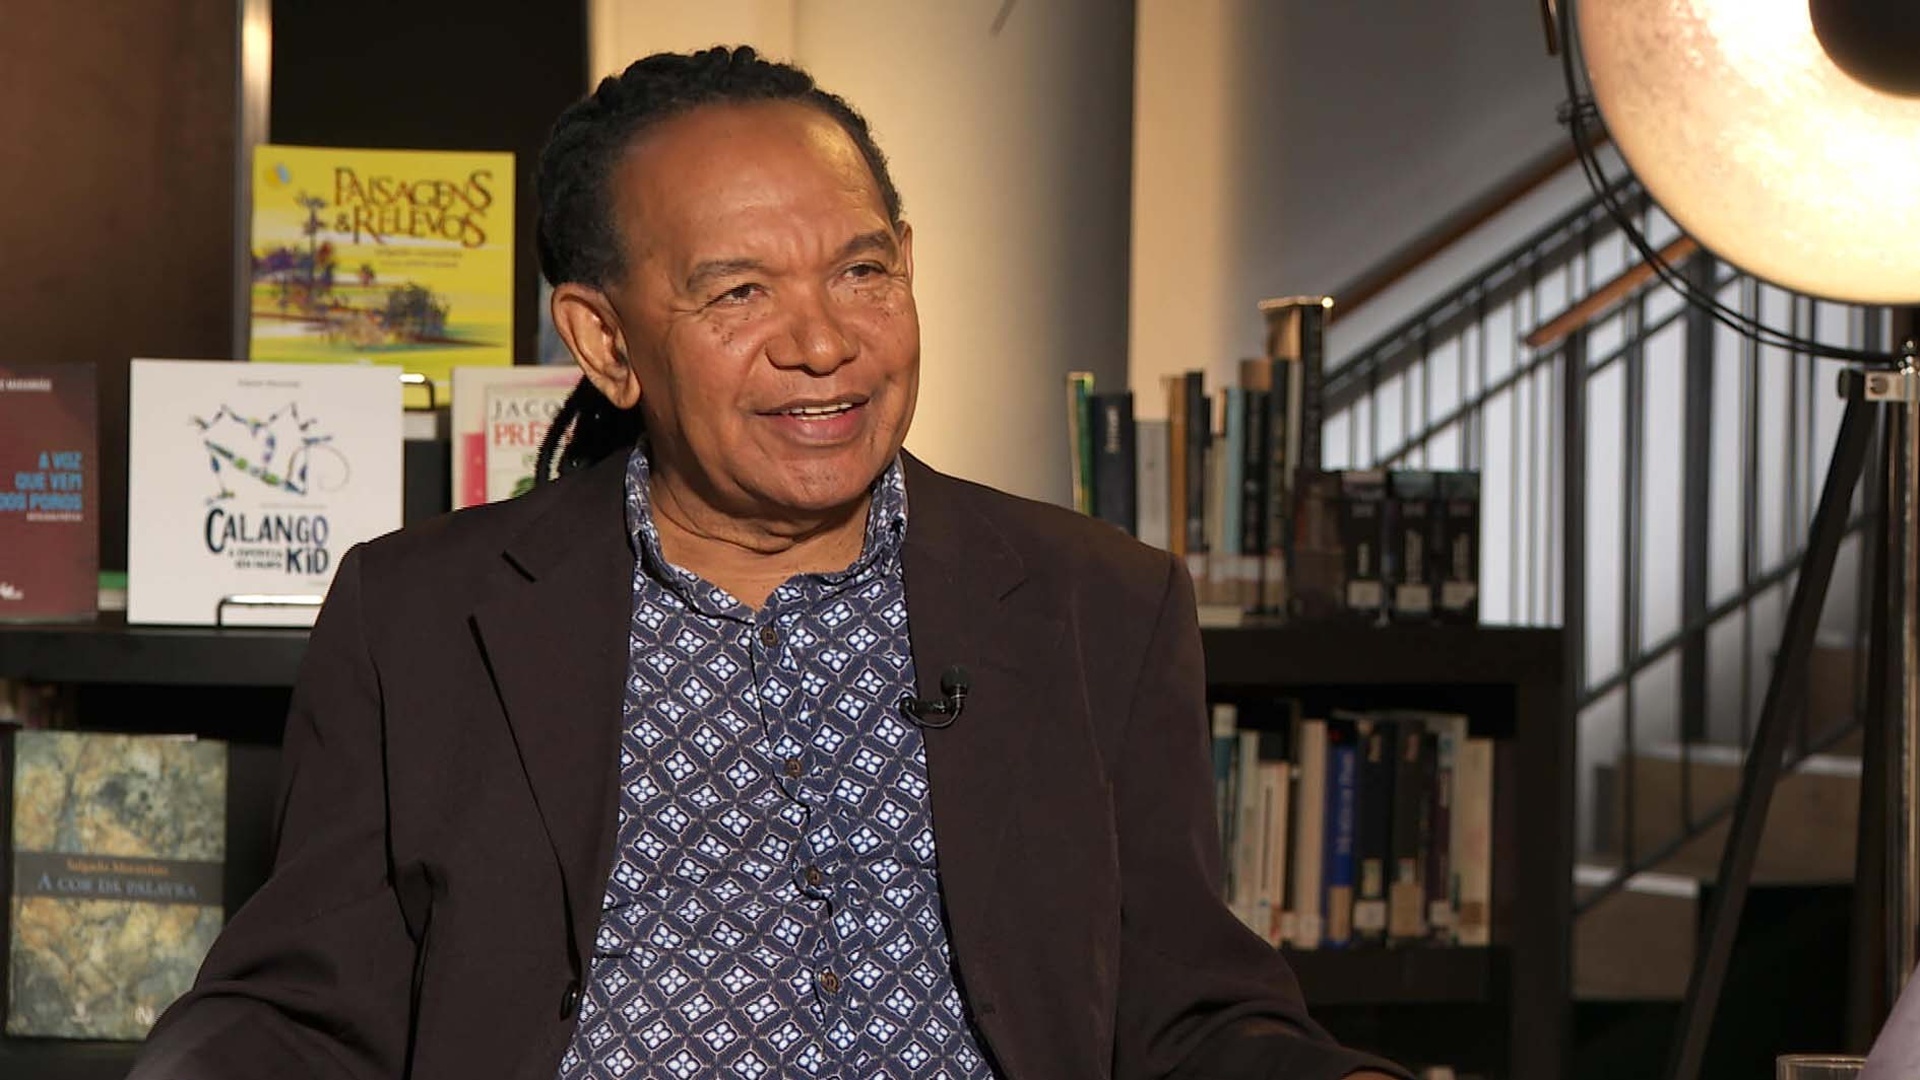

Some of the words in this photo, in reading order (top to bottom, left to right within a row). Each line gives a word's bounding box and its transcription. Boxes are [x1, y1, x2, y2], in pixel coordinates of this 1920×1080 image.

[335, 166, 494, 217] PAISAGENS
[39, 452, 49, 470] A
[53, 451, 82, 470] VOZ
[15, 472, 45, 490] QUE
[30, 491, 82, 510] POROS
[204, 507, 329, 553] CALANGO
[38, 872, 51, 890] A
